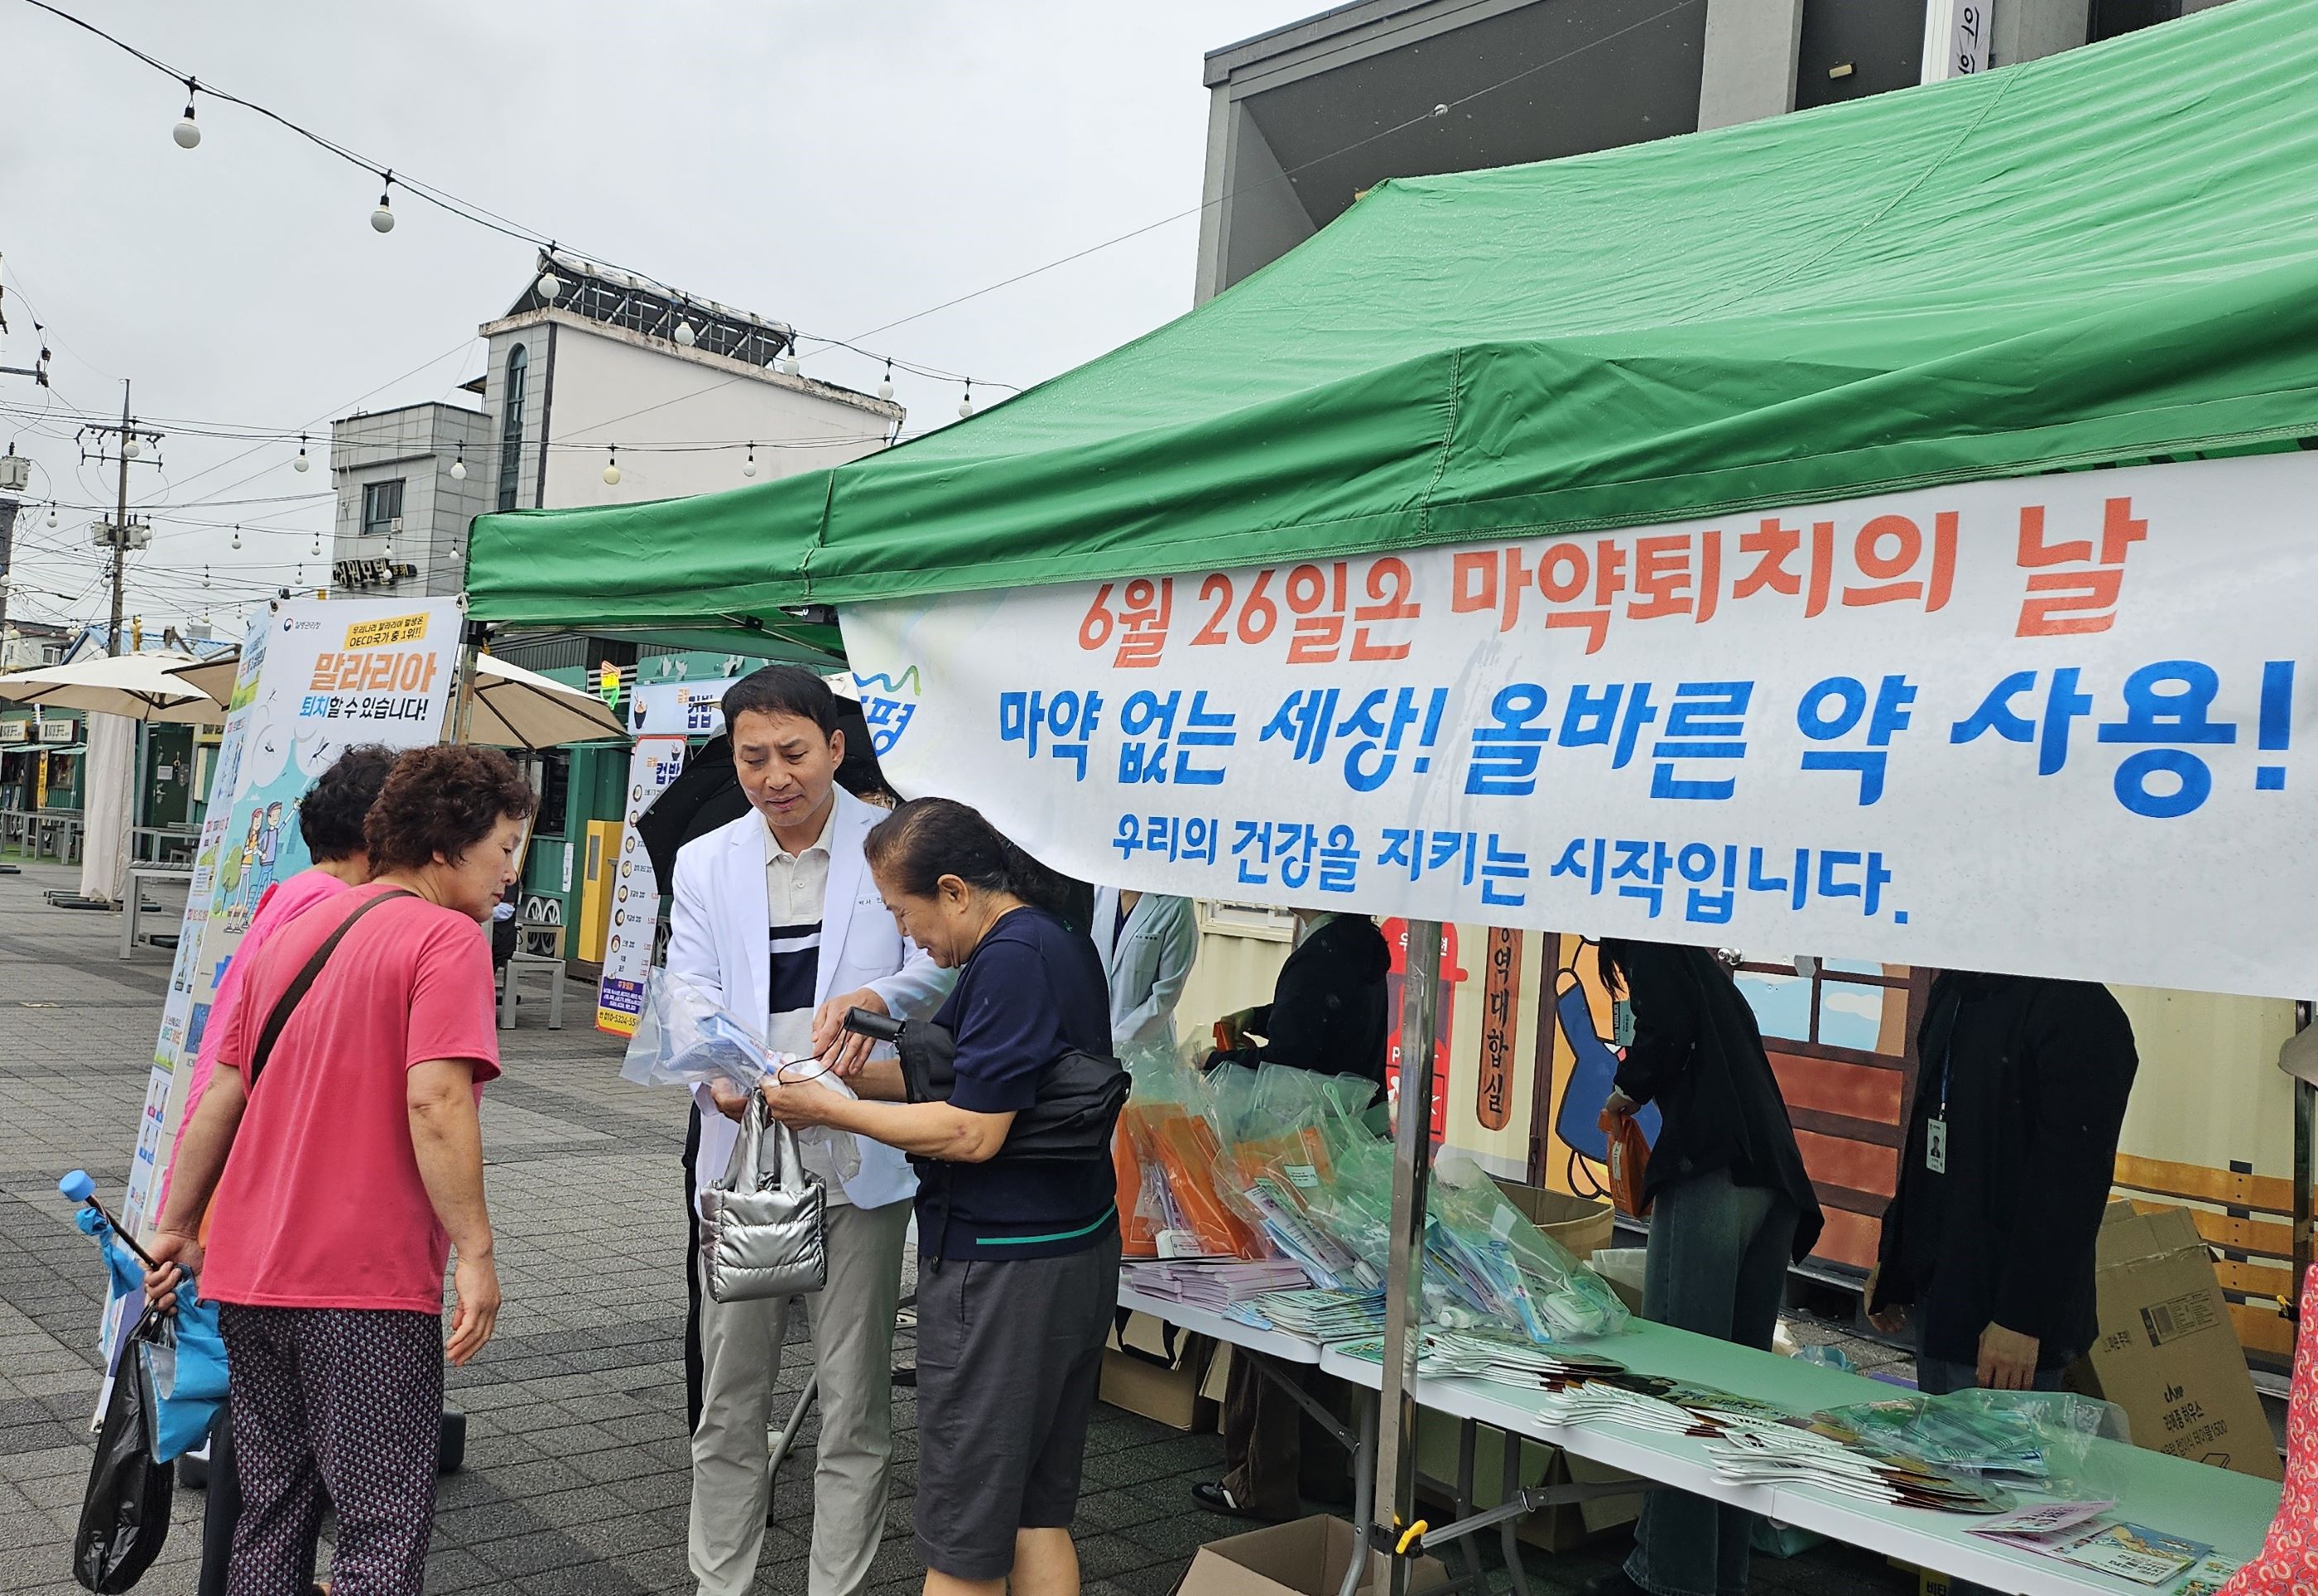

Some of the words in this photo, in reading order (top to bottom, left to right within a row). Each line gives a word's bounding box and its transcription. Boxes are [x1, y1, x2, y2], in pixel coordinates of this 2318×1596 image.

[1079, 579, 1172, 668] 6월
[1191, 563, 1421, 664] 26일은
[1452, 512, 1960, 654] 마약퇴치의
[2016, 497, 2148, 637] 날
[349, 631, 390, 647] OECD국가
[390, 629, 401, 642] 중
[401, 626, 421, 641] 1위!!
[352, 623, 378, 635] 우리나라
[378, 619, 404, 632] 말라리아
[404, 615, 425, 627] 발생은
[309, 651, 439, 694] 말라리아
[299, 695, 344, 719] 퇴치할
[344, 697, 358, 719] 수
[358, 697, 430, 722] 있습니다!
[860, 695, 917, 757] 평
[999, 690, 1104, 782] 마약
[1118, 690, 1237, 786] 없는
[1258, 687, 1449, 792] 세상!
[1464, 680, 1755, 800] 올바른
[1796, 675, 1919, 806] 약
[1950, 660, 2296, 819] 사용!
[1113, 814, 1219, 867] 우리의
[1231, 820, 1362, 893] 건강을
[1377, 828, 1531, 906] 지키는
[1550, 838, 1909, 925] 시작입니다.
